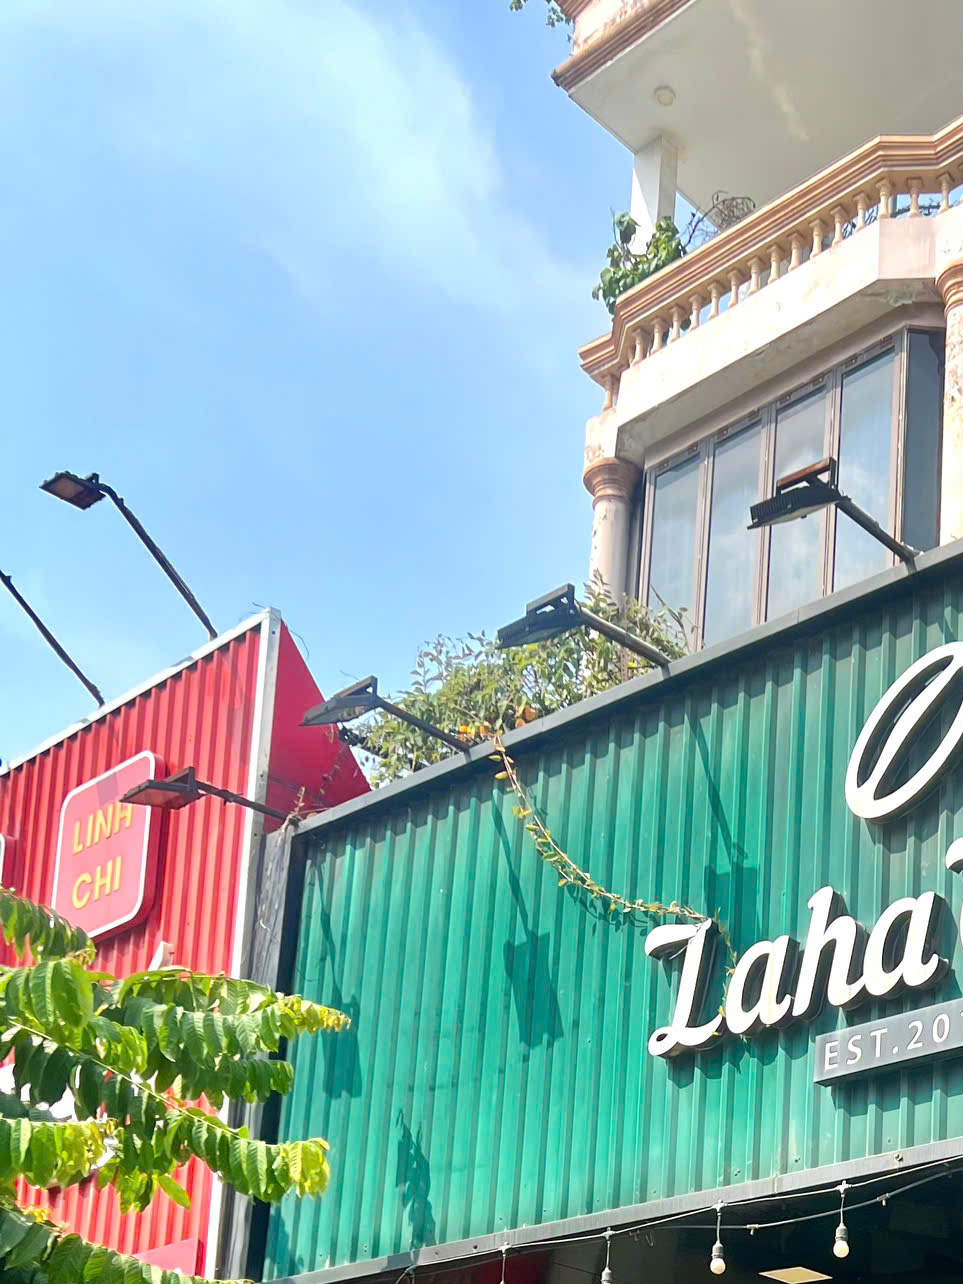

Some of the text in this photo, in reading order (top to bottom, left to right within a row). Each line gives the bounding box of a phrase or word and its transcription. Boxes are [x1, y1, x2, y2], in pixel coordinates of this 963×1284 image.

[73, 800, 133, 855] LINH
[72, 856, 122, 909] CHI
[644, 885, 950, 1059] Laha
